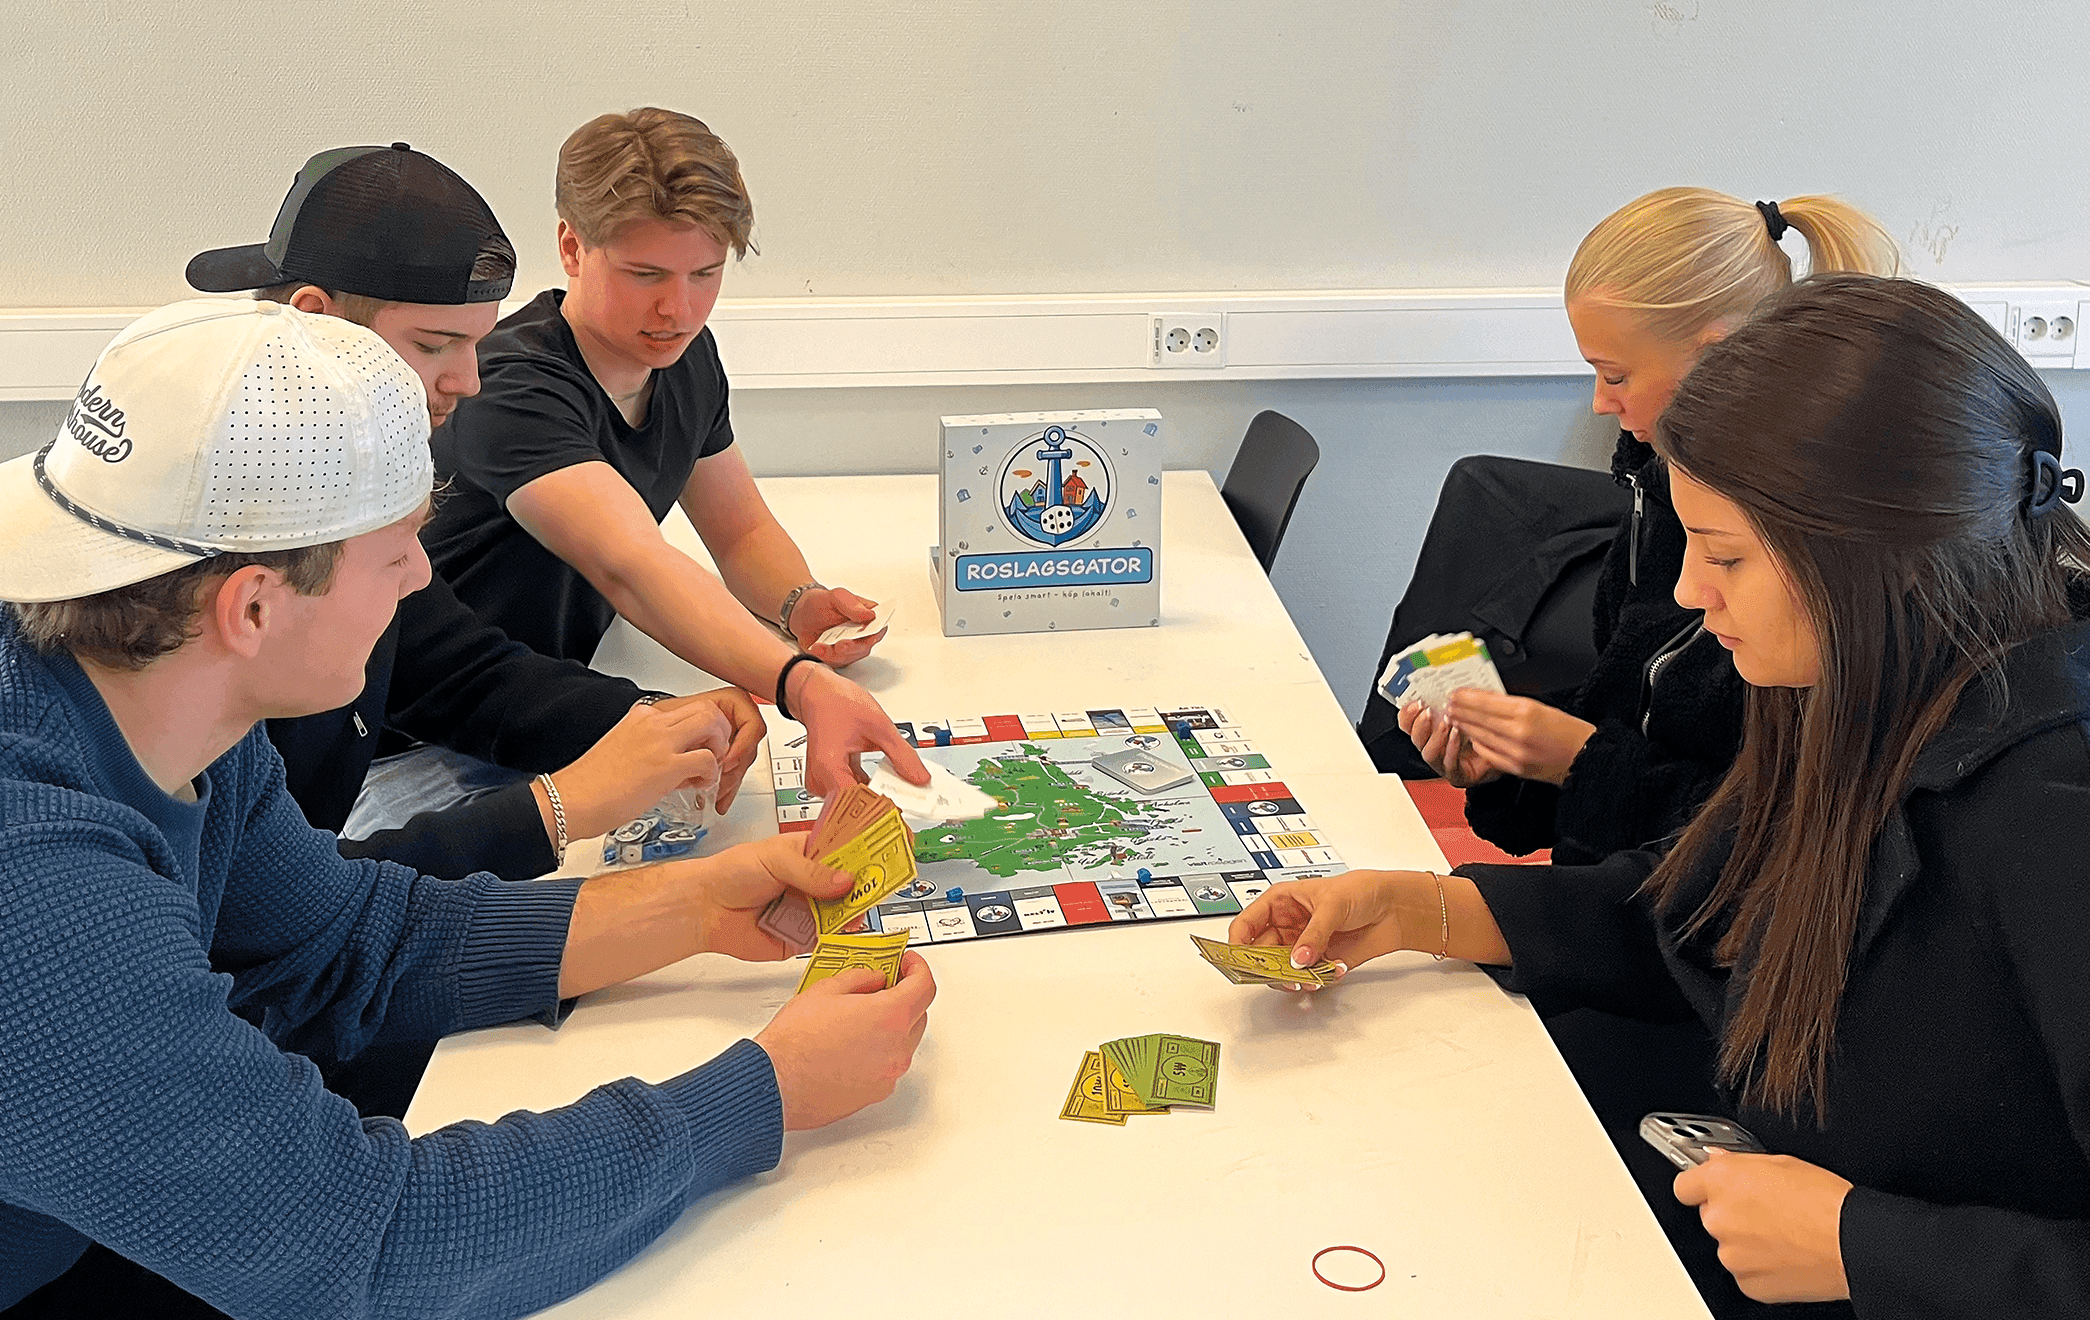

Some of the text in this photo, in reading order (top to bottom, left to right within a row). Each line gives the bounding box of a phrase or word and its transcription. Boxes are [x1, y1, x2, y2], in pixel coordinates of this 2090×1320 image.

[967, 557, 1141, 581] ROSLAGSGATOR
[997, 593, 1021, 602] Spela
[1025, 591, 1051, 600] smart
